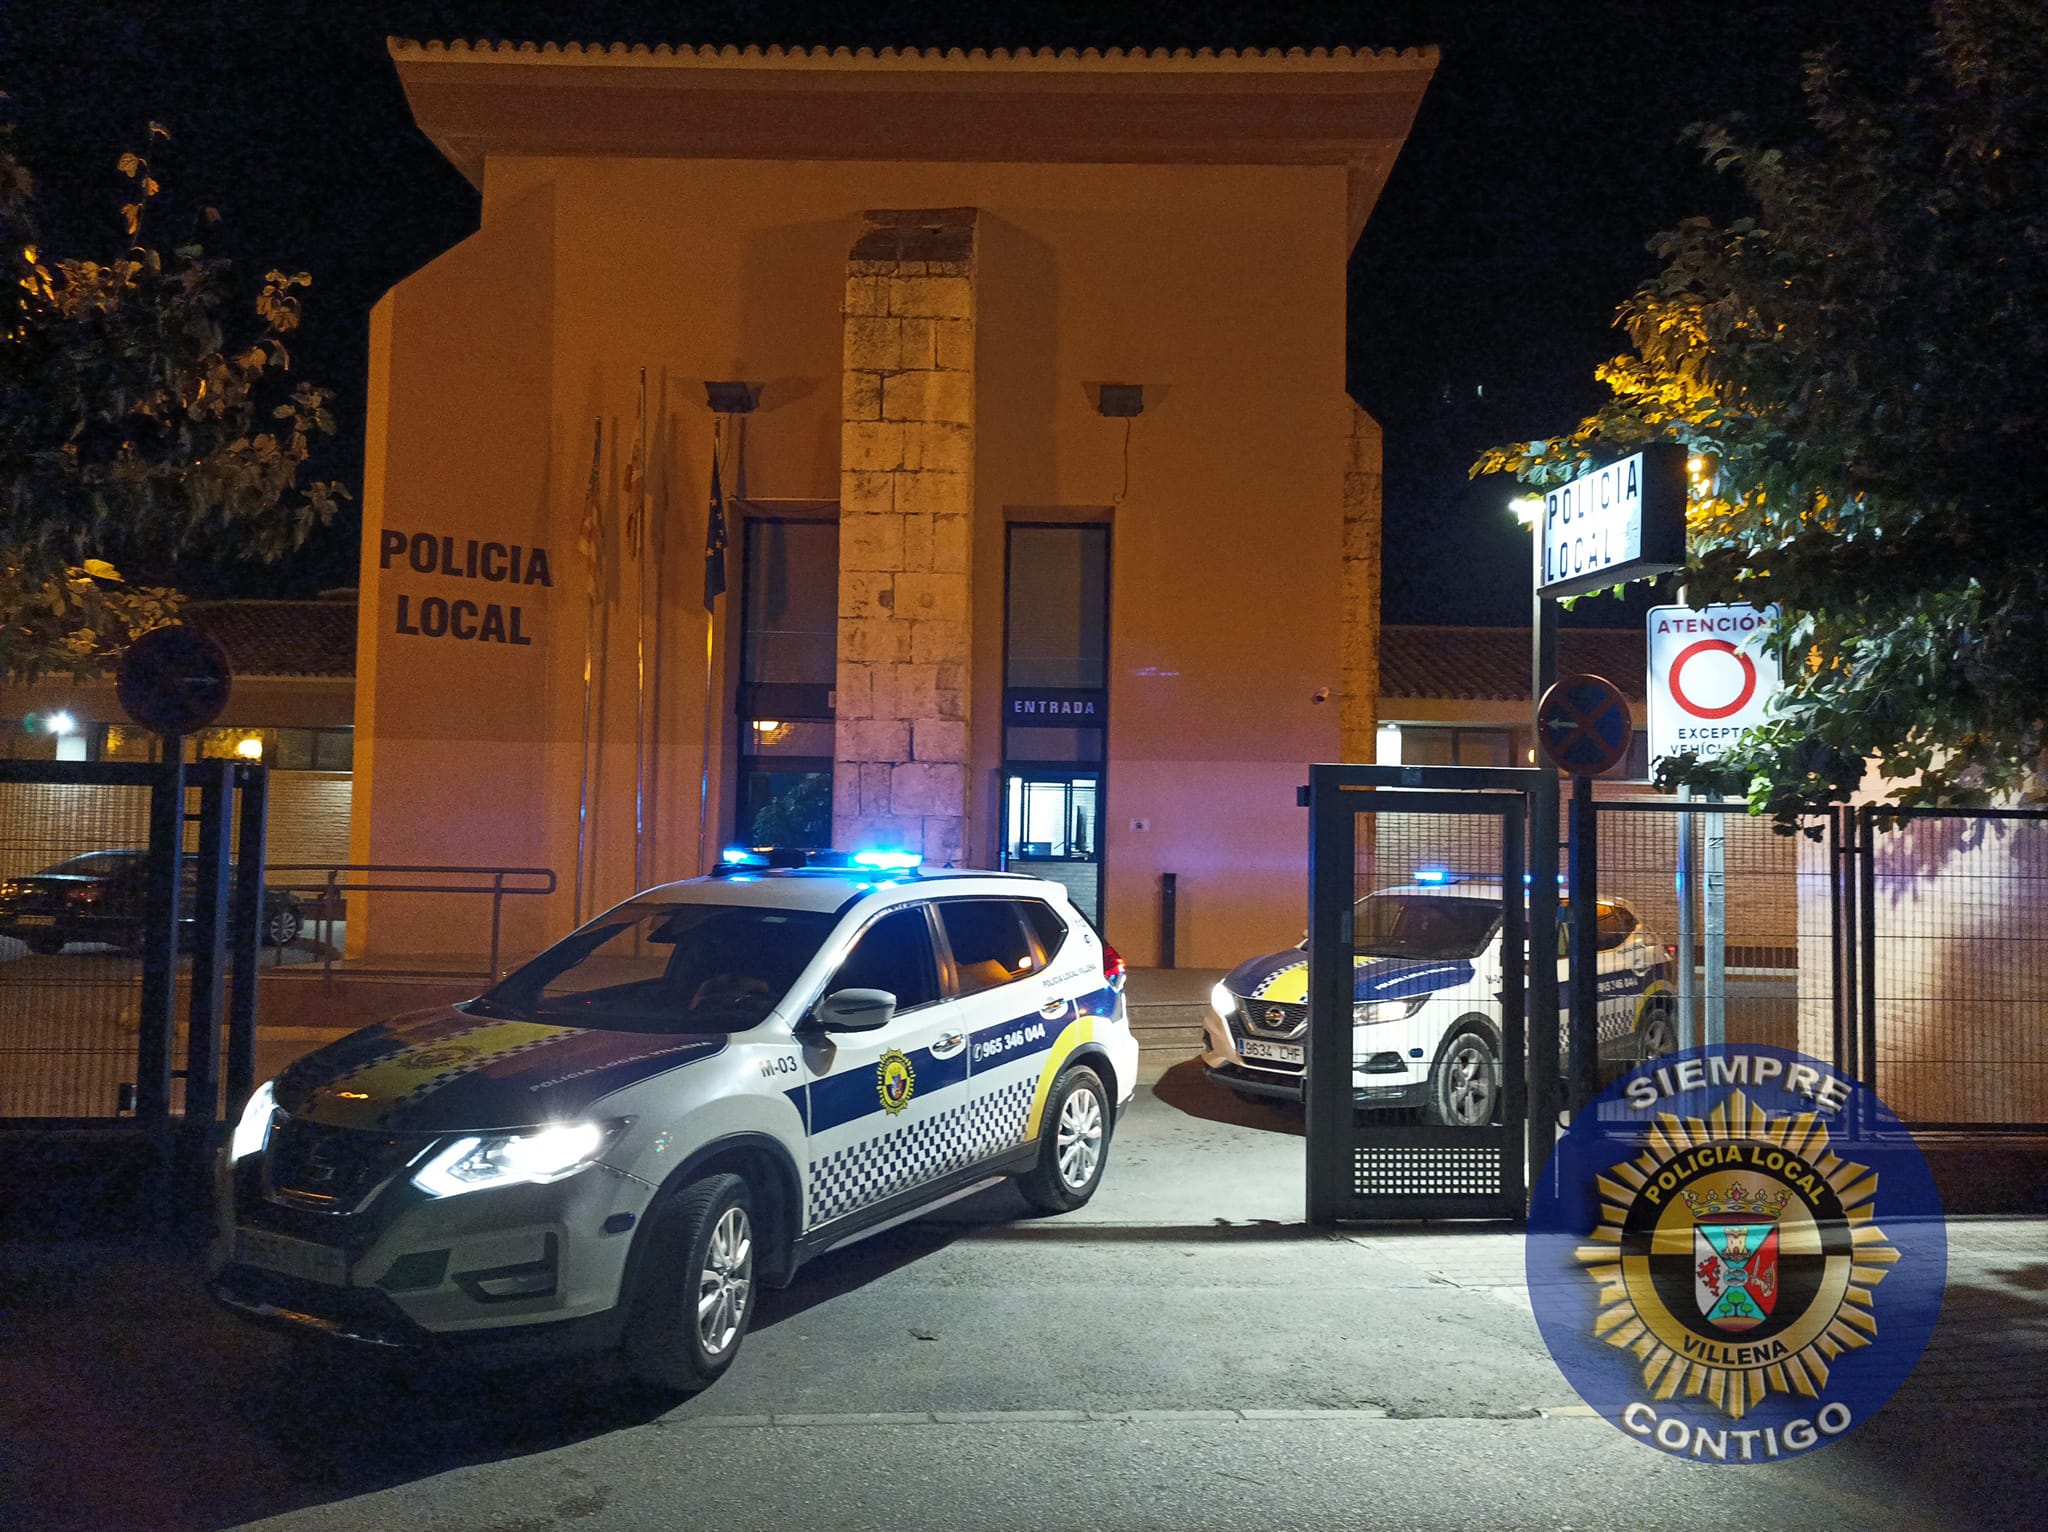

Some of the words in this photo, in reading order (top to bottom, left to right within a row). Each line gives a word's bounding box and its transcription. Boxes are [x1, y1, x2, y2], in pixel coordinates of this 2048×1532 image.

[1548, 459, 1637, 530] POLICIA
[380, 529, 553, 587] POLICIA
[1547, 527, 1611, 581] LOCAL
[396, 594, 531, 645] LOCAL
[1014, 700, 1095, 714] ENTRADA
[982, 1037, 1003, 1058] 965
[1003, 1029, 1024, 1050] 346
[1024, 1022, 1045, 1042] 044
[1246, 1042, 1272, 1057] 9634
[529, 1068, 597, 1092] POLICIA
[759, 1055, 798, 1078] M-03
